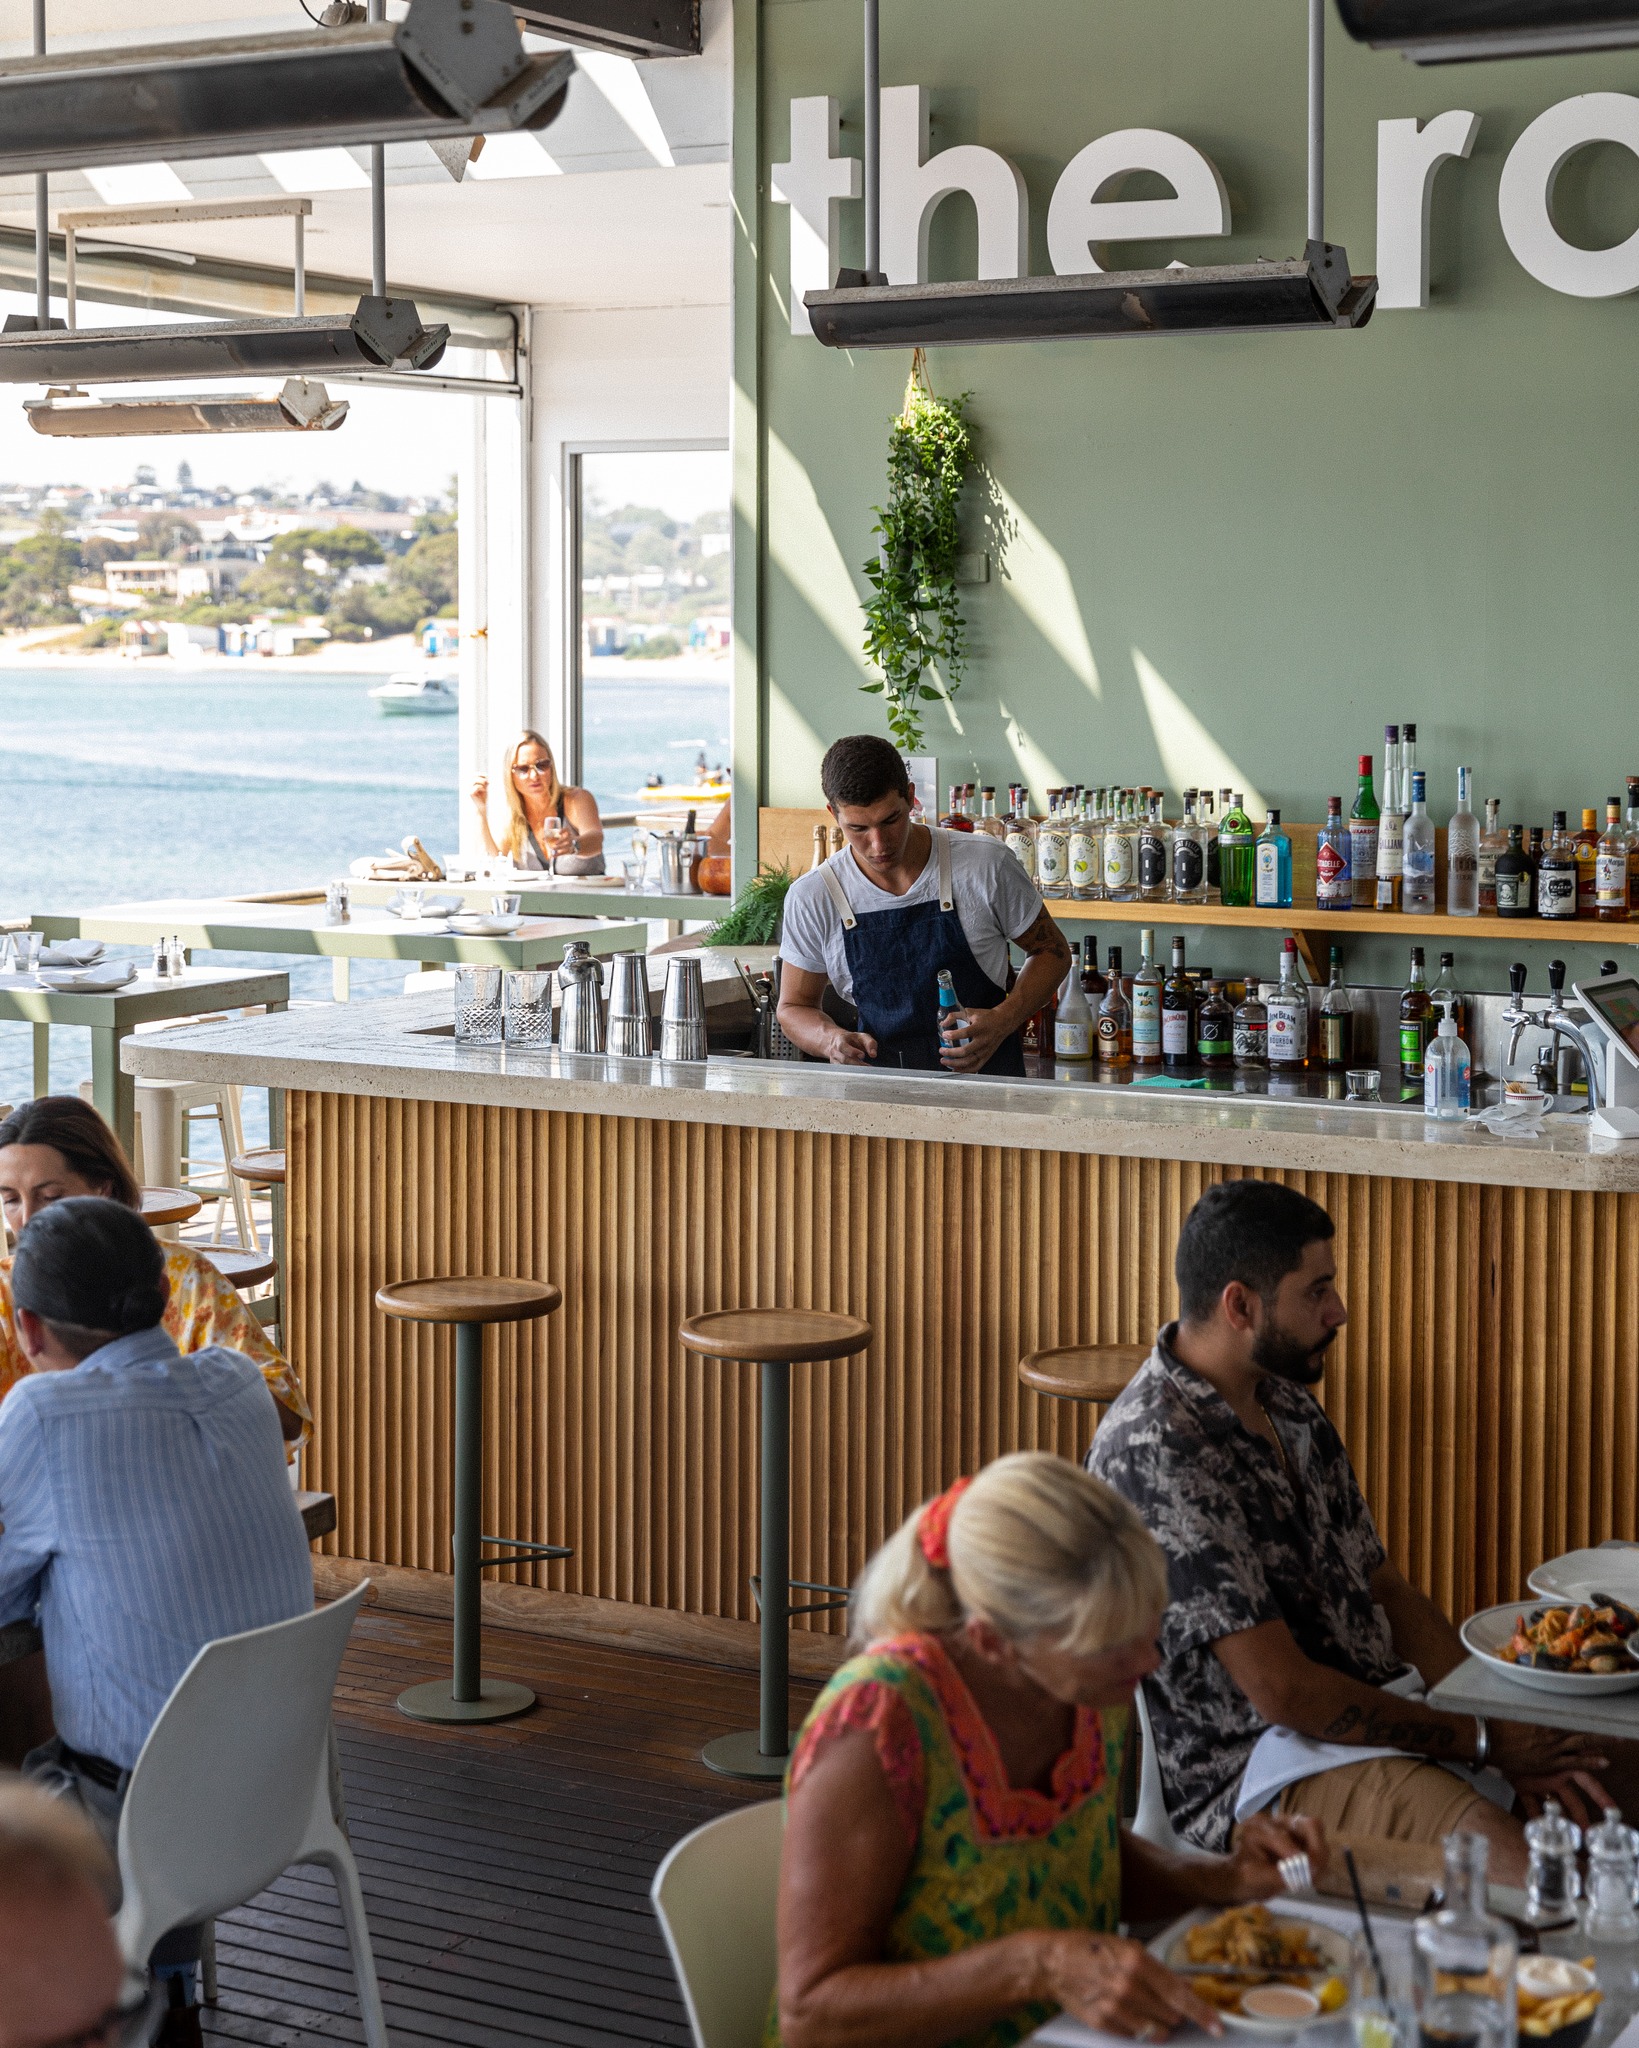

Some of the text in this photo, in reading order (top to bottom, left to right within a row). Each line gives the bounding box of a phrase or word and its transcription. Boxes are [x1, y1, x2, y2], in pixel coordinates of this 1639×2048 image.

[771, 85, 1232, 336] the
[1278, 1010, 1296, 1024] BEAM
[1100, 1022, 1113, 1032] 43
